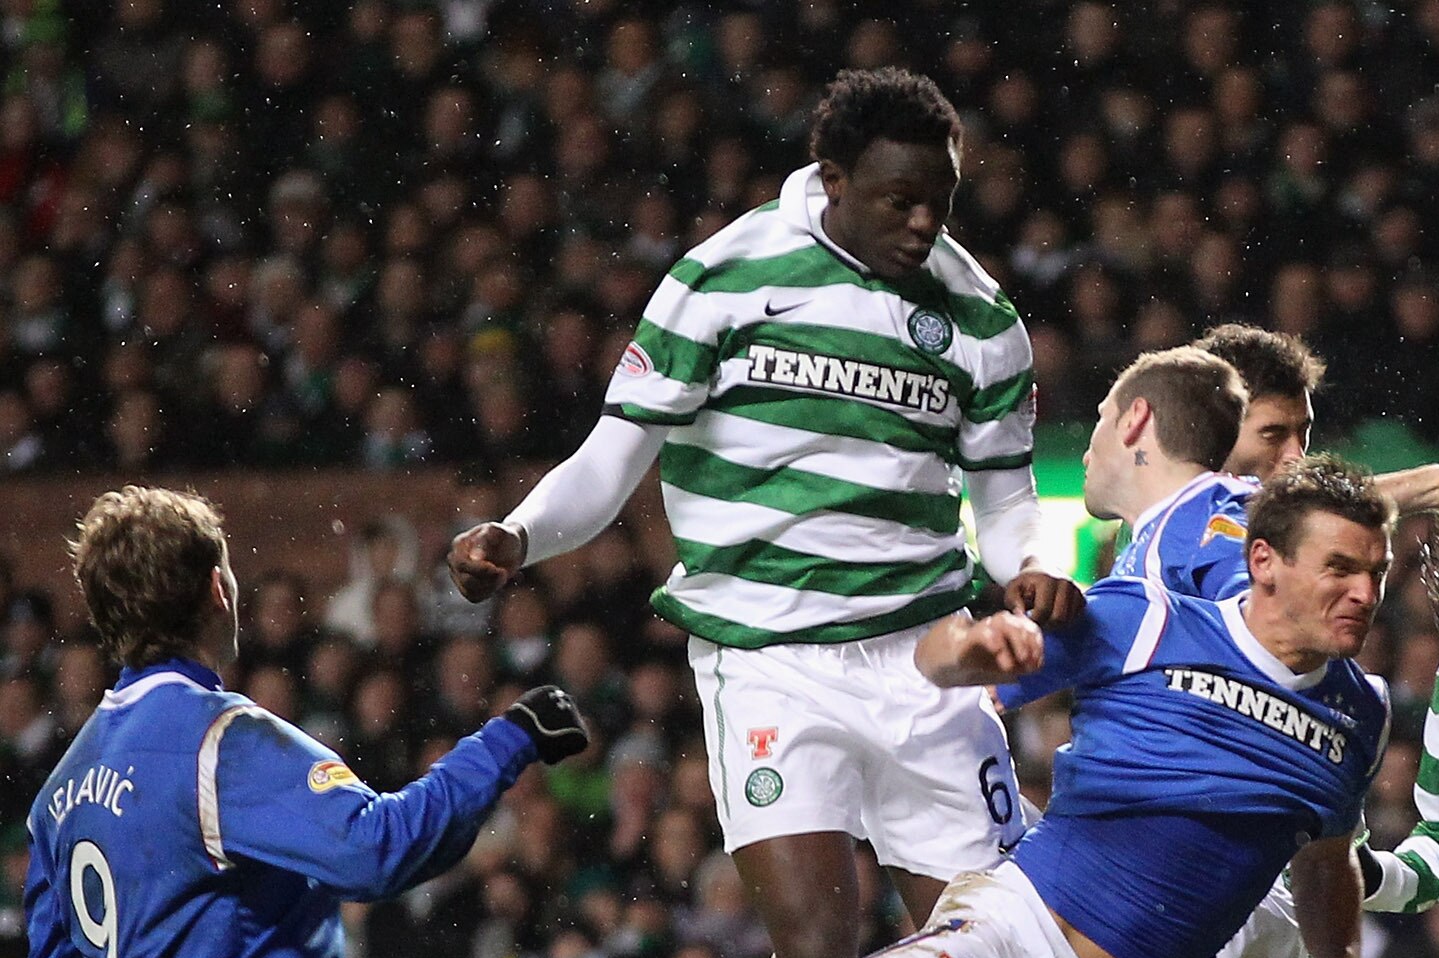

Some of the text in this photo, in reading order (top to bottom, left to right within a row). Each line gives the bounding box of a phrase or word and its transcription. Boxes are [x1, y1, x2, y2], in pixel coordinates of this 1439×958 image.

[748, 343, 948, 413] TENNENT'S
[1165, 668, 1346, 764] TENNENT'S
[978, 755, 1013, 825] 6
